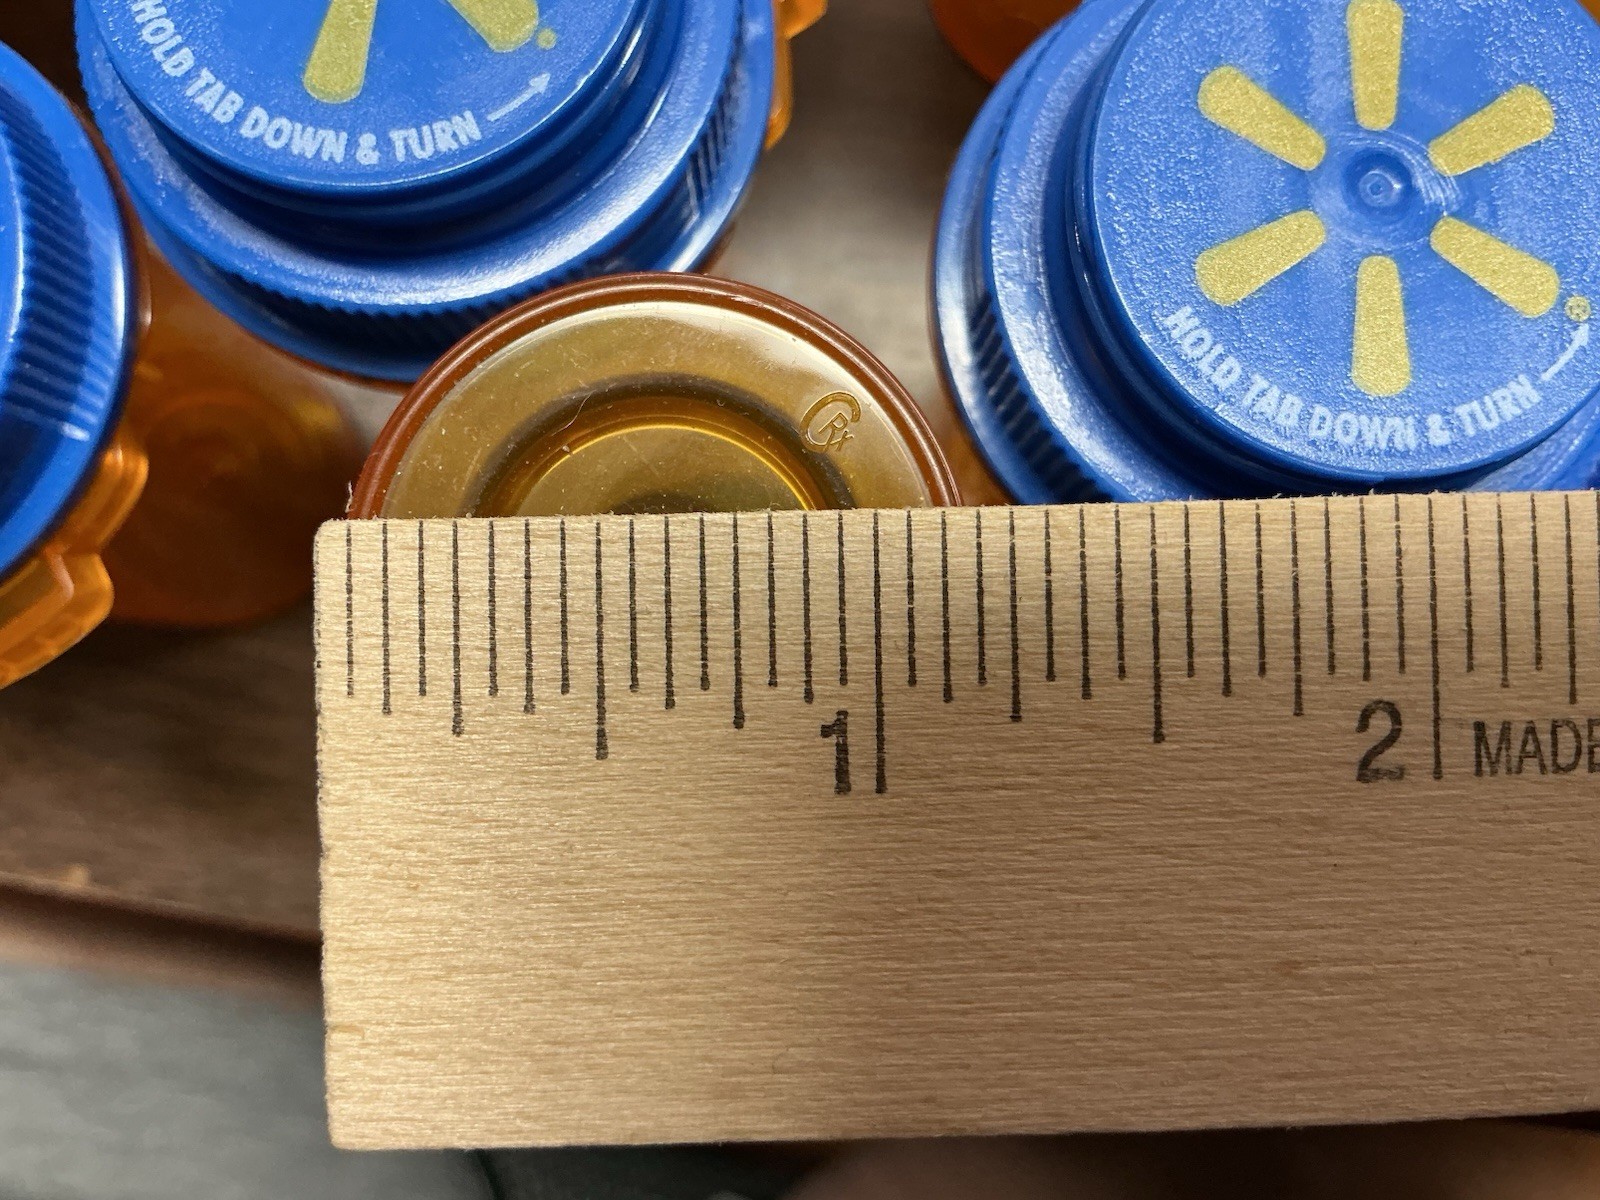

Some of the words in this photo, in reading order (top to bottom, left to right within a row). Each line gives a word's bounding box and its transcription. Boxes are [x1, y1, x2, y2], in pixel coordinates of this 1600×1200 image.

[131, 0, 195, 77] HOLD
[184, 68, 244, 124] TAB
[241, 107, 347, 163] DOWN
[355, 132, 381, 166] &
[389, 111, 482, 163] TURN
[1163, 306, 1242, 391] HOLD
[1242, 373, 1303, 428] TAB
[1309, 406, 1417, 451] DOWN
[1427, 413, 1454, 446] &
[1454, 373, 1542, 436] TURN
[820, 710, 851, 794] 1
[1355, 700, 1405, 783] 2
